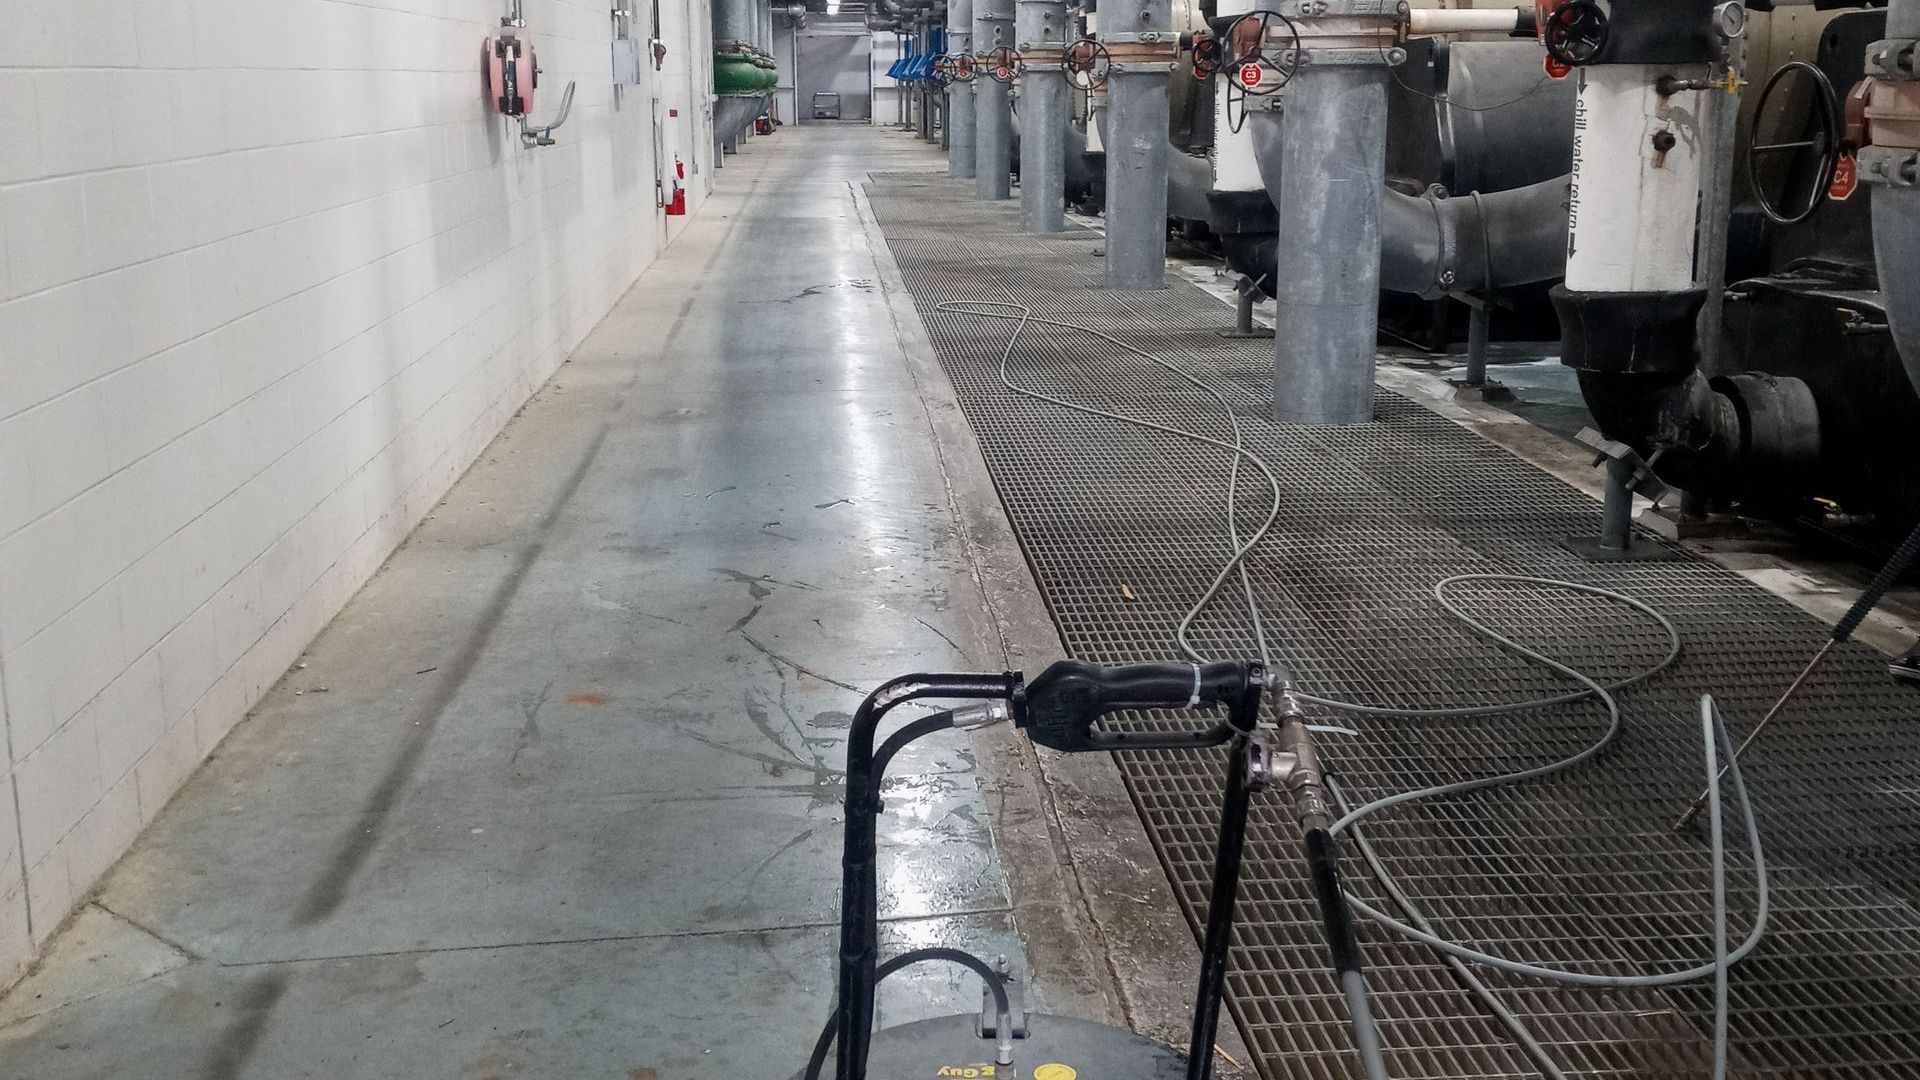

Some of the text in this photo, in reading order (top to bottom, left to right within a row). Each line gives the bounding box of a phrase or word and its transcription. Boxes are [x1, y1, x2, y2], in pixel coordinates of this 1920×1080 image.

[1245, 71, 1257, 79] C3
[1569, 99, 1587, 229] chill water return
[1833, 170, 1849, 184] C4
[936, 1066, 979, 1078] Guy
